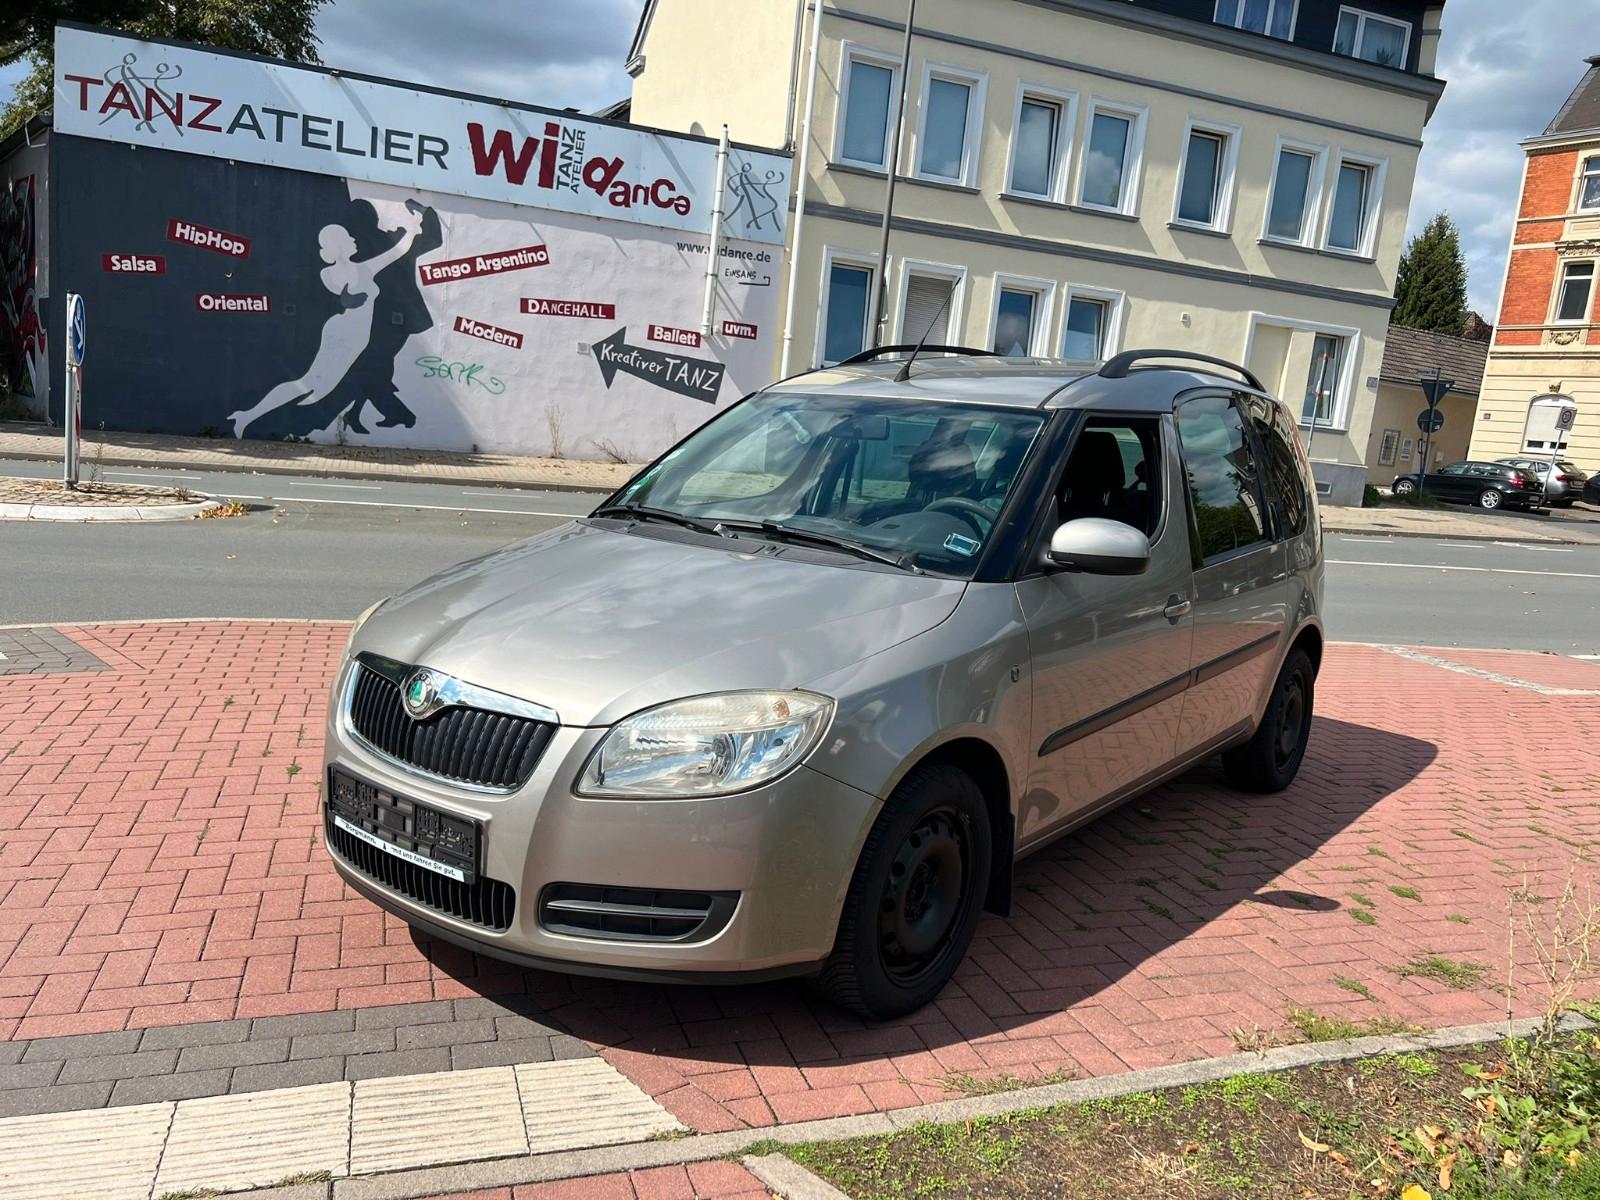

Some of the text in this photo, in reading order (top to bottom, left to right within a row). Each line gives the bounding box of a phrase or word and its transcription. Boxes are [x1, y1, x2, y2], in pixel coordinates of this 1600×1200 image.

[555, 126, 577, 191] TANZ
[570, 130, 587, 194] ATELIER
[175, 222, 246, 255] HipHop
[676, 242, 771, 263] www.idance.de
[110, 255, 157, 272] Salsa
[422, 250, 548, 281] Tango Argentino
[199, 294, 268, 312] Oriental
[527, 298, 607, 318] DANCEHALL
[459, 318, 519, 348] Modern
[653, 326, 697, 346] Ballett
[724, 322, 755, 337] uvm.
[600, 343, 720, 392] Kreativer TANZ
[402, 851, 413, 859] uns
[413, 855, 432, 867] fahren
